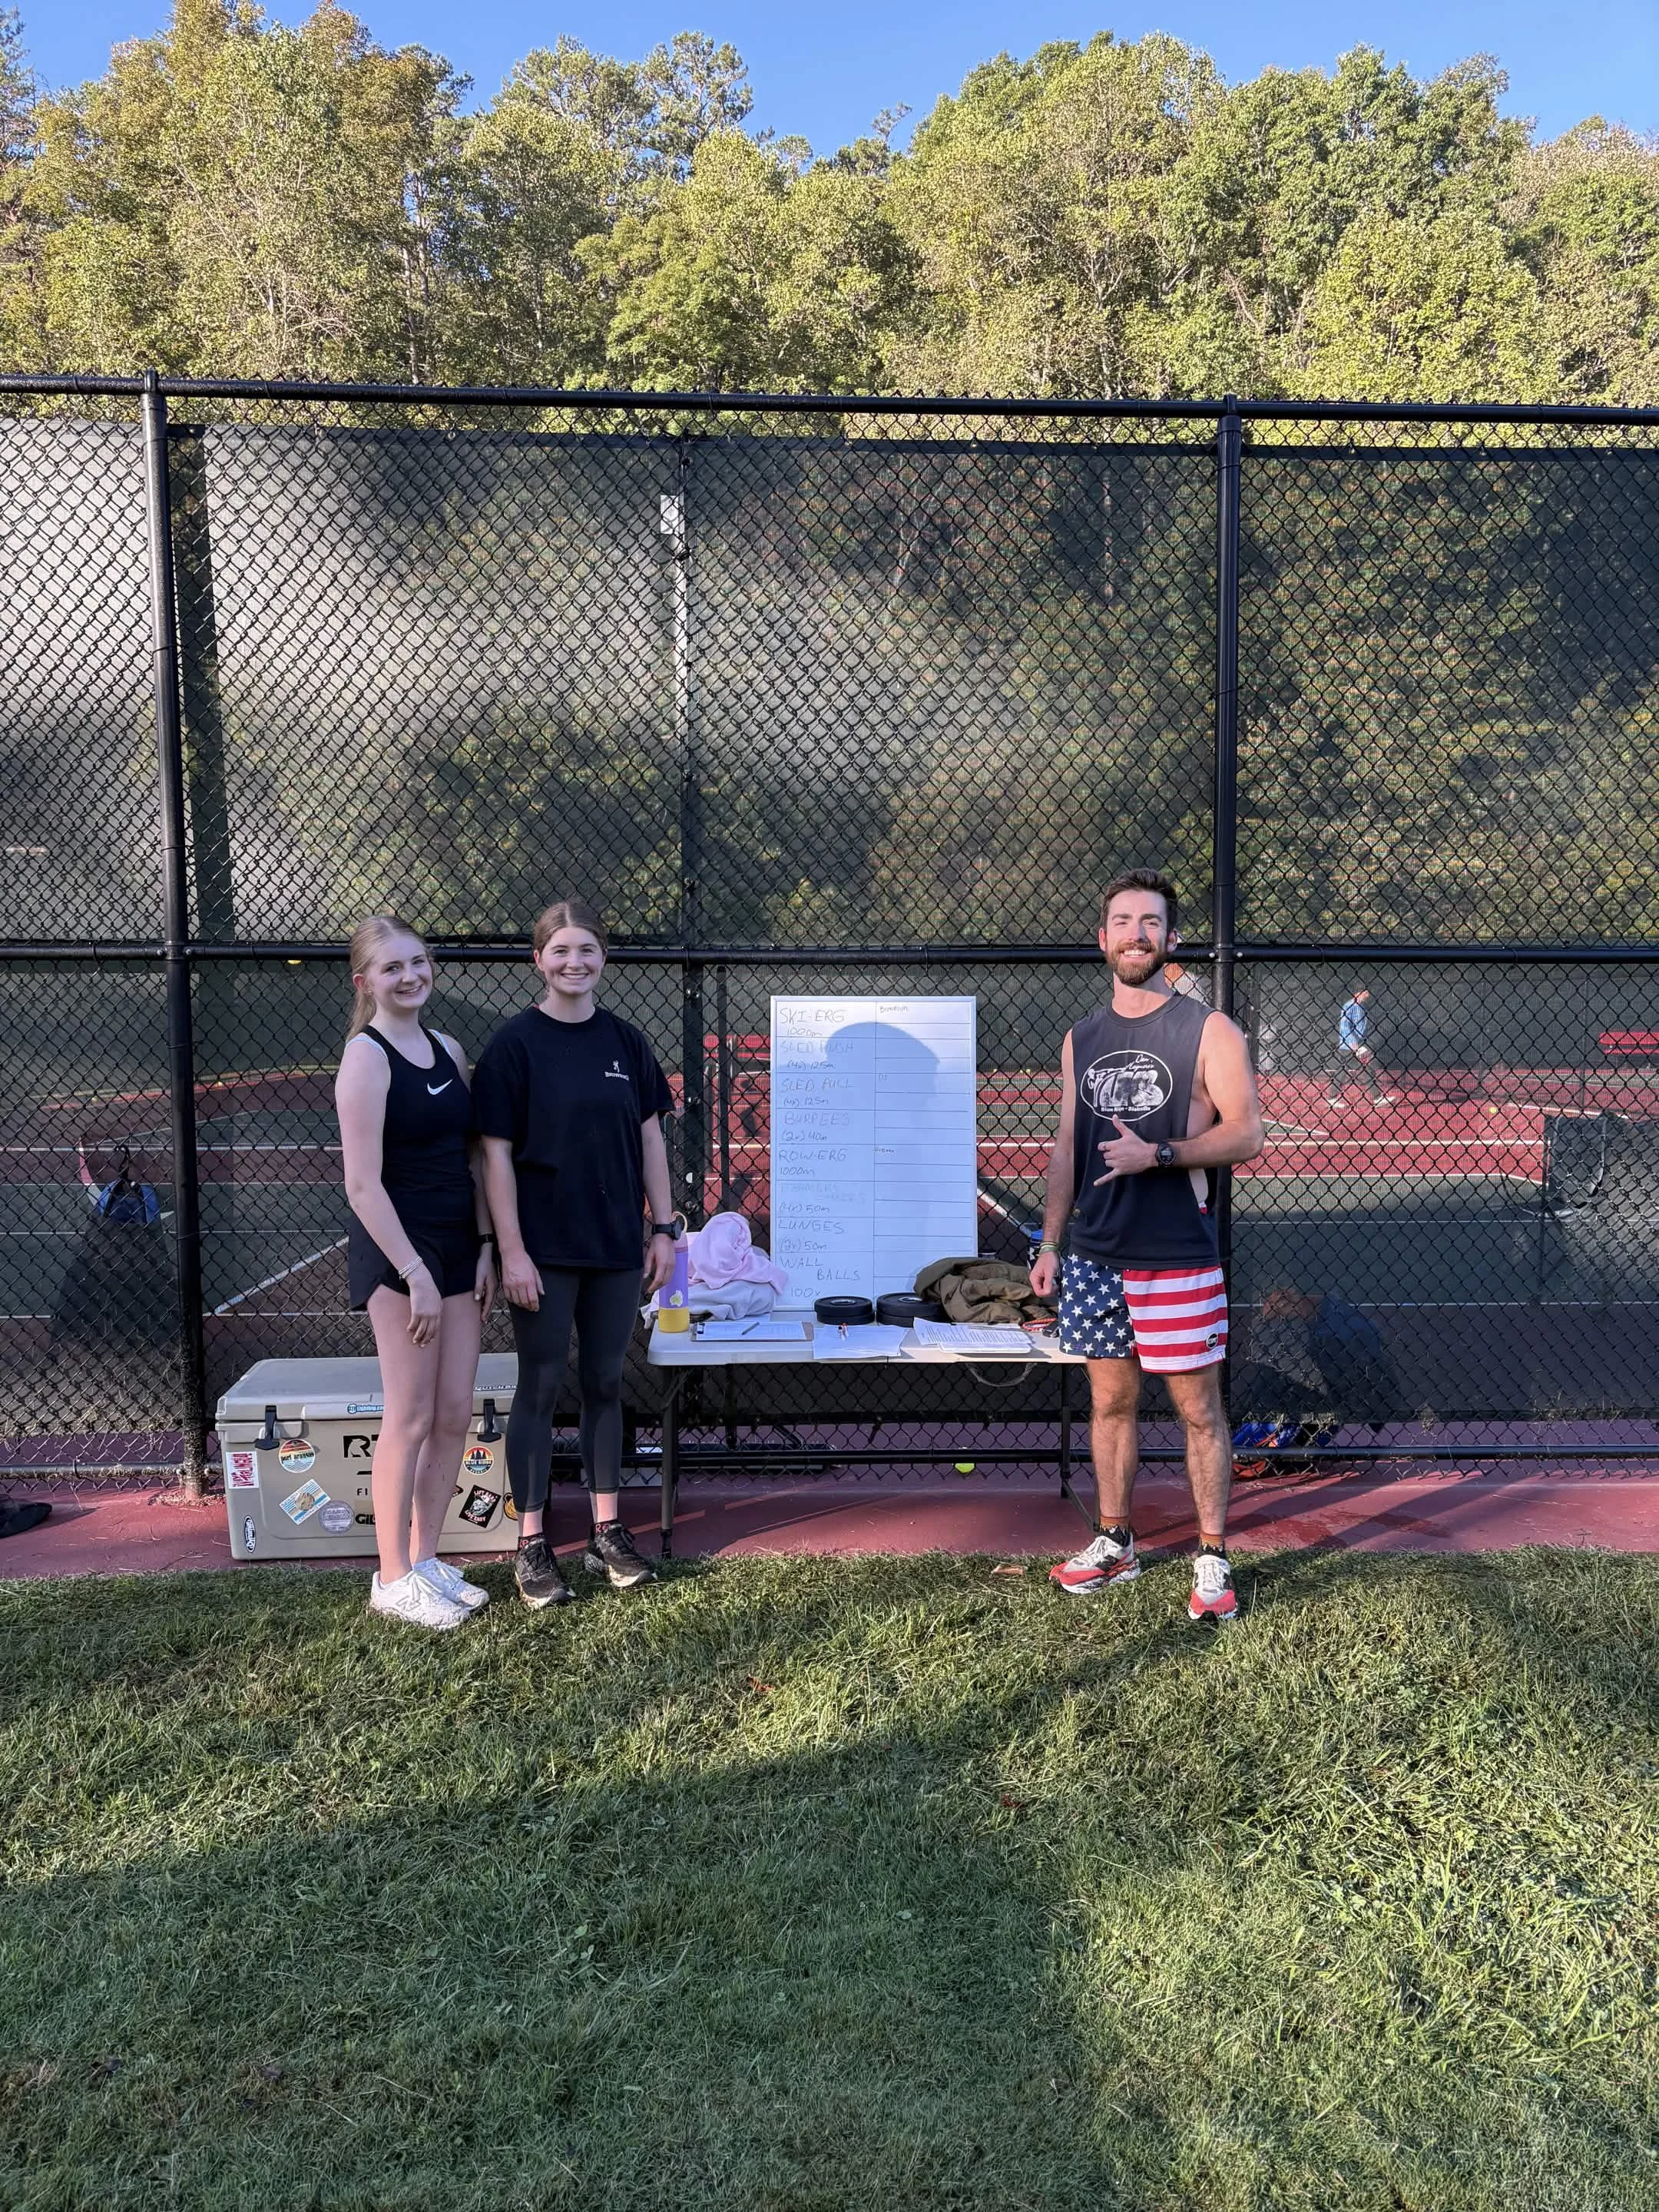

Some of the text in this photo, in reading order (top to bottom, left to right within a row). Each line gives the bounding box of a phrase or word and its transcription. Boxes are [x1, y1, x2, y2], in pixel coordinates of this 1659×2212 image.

[780, 1078, 815, 1092] SLED
[784, 1111, 849, 1126] BURPEES
[778, 1220, 845, 1235] LUNGES
[804, 1240, 827, 1251] 50m
[780, 1256, 824, 1269] WALL
[816, 1268, 861, 1282] BALLS
[790, 1286, 821, 1298] 100x
